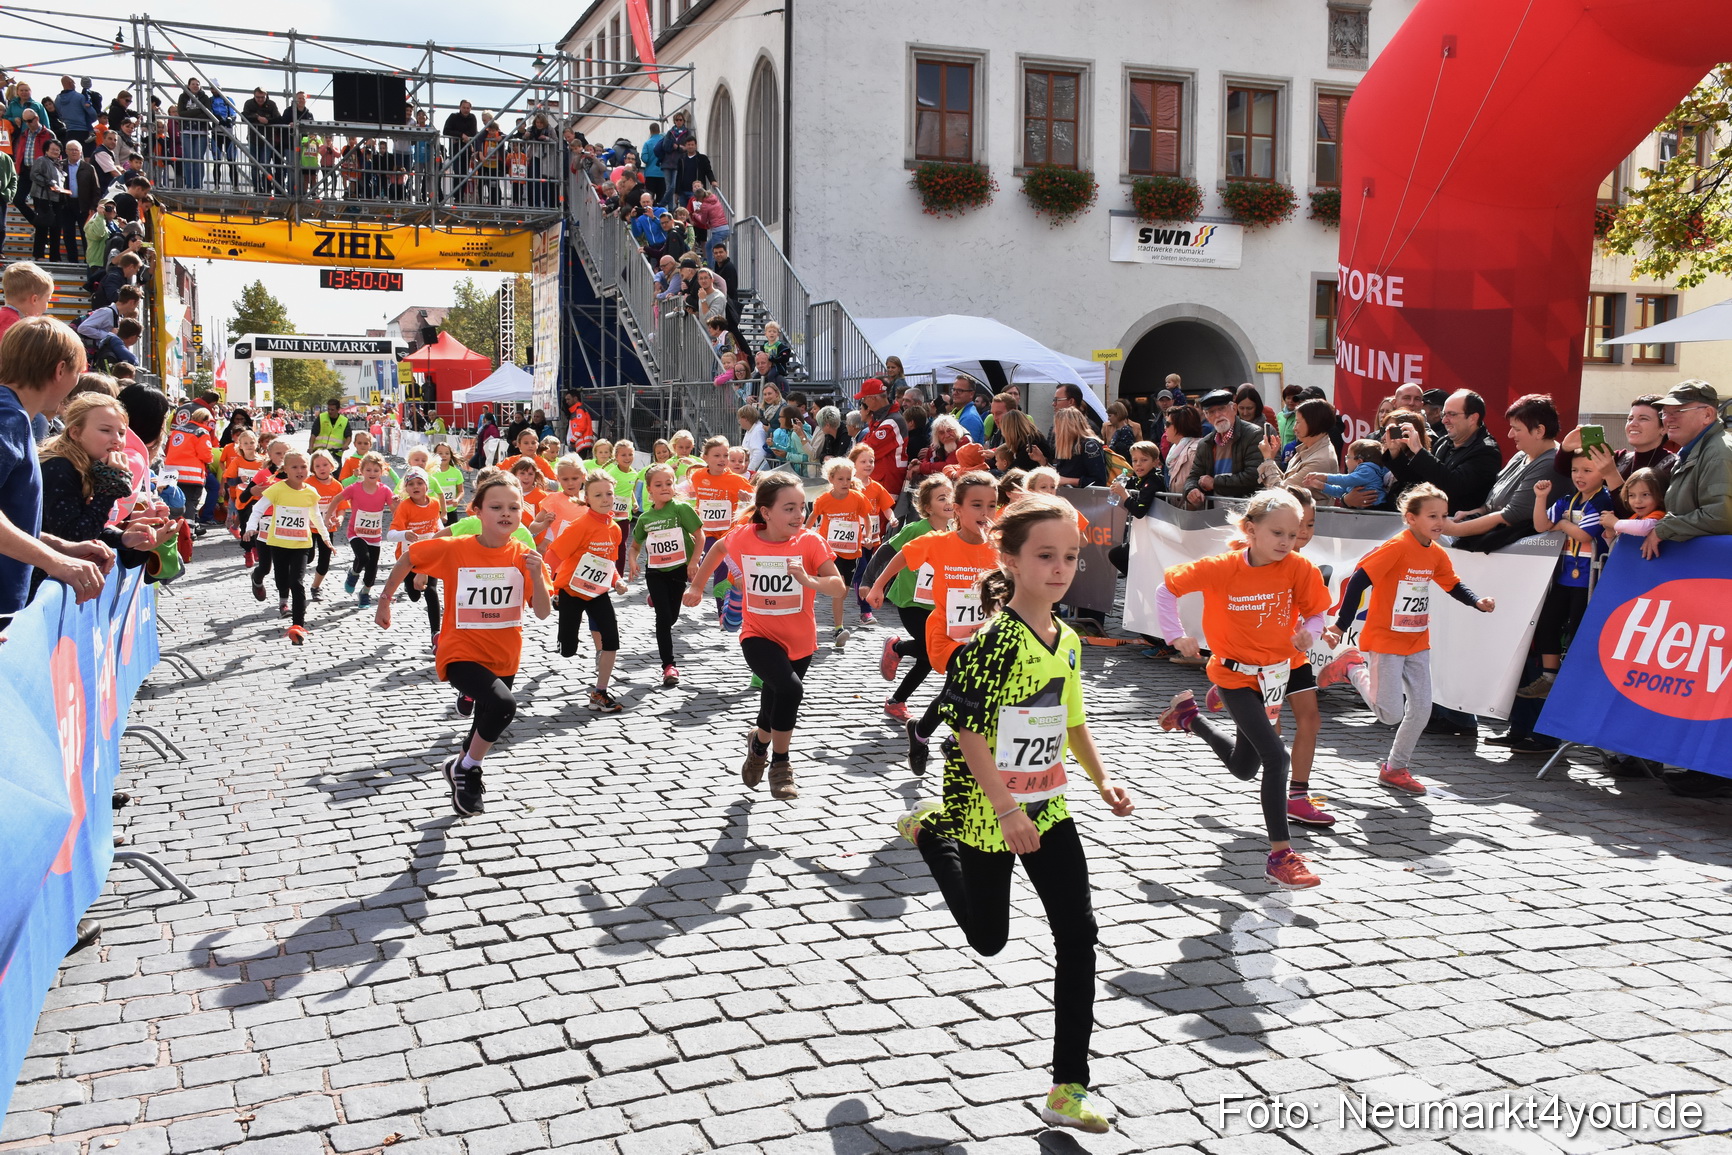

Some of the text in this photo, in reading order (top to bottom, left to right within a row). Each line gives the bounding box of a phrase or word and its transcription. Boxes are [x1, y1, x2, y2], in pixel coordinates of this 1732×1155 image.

[1138, 227, 1192, 247] swn
[312, 231, 395, 260] ZIEL
[1137, 245, 1205, 256] stadtwerke neumarkt
[1160, 254, 1178, 262] bieten
[267, 339, 300, 350] MINI
[703, 510, 727, 519] 7207
[280, 516, 305, 528] 7245
[360, 518, 380, 528] 7215
[833, 530, 855, 541] 7249
[651, 540, 679, 554] 7085
[581, 565, 608, 584] 7187
[750, 574, 793, 593] 7002
[467, 586, 513, 606] 7107
[1227, 603, 1266, 612] Stadtlauf
[1402, 597, 1429, 612] 7253
[956, 605, 988, 622] 719
[1623, 670, 1695, 697] SPORTS
[1013, 733, 1063, 766] 7259
